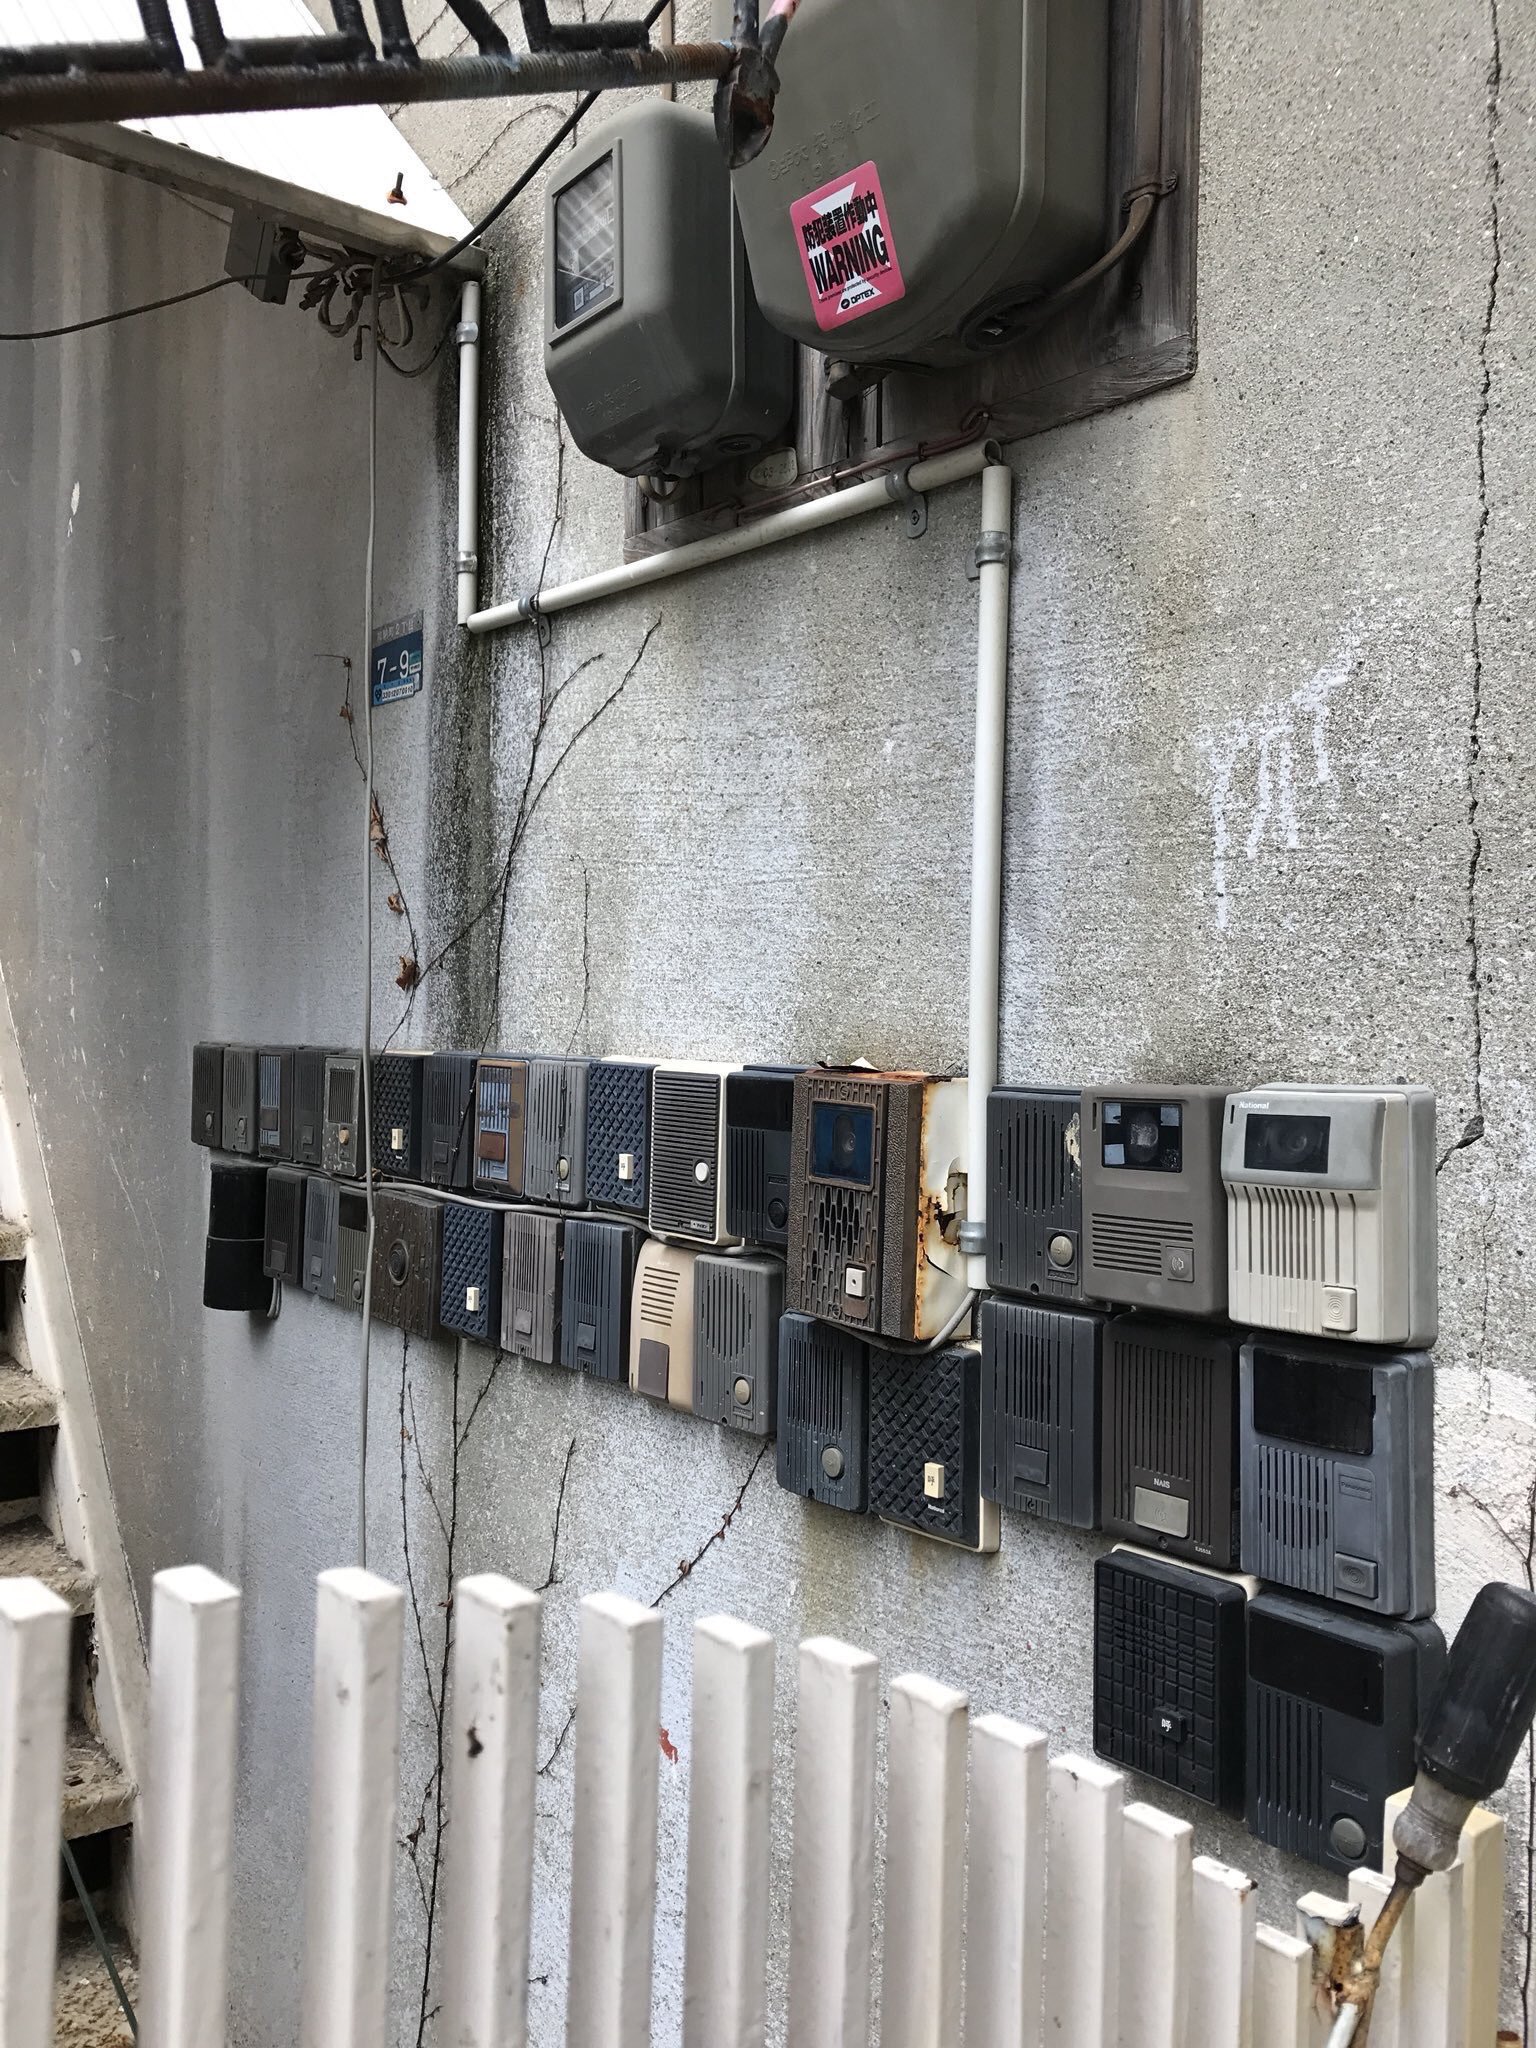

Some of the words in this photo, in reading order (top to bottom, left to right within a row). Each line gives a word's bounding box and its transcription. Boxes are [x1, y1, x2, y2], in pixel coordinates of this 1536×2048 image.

[802, 190, 878, 251] 防犯装置作動中
[809, 224, 890, 295] WARNING
[850, 288, 875, 304] OPTEX
[377, 649, 409, 684] 7-9
[1239, 1101, 1270, 1109] National
[1153, 1478, 1171, 1489] NAIS
